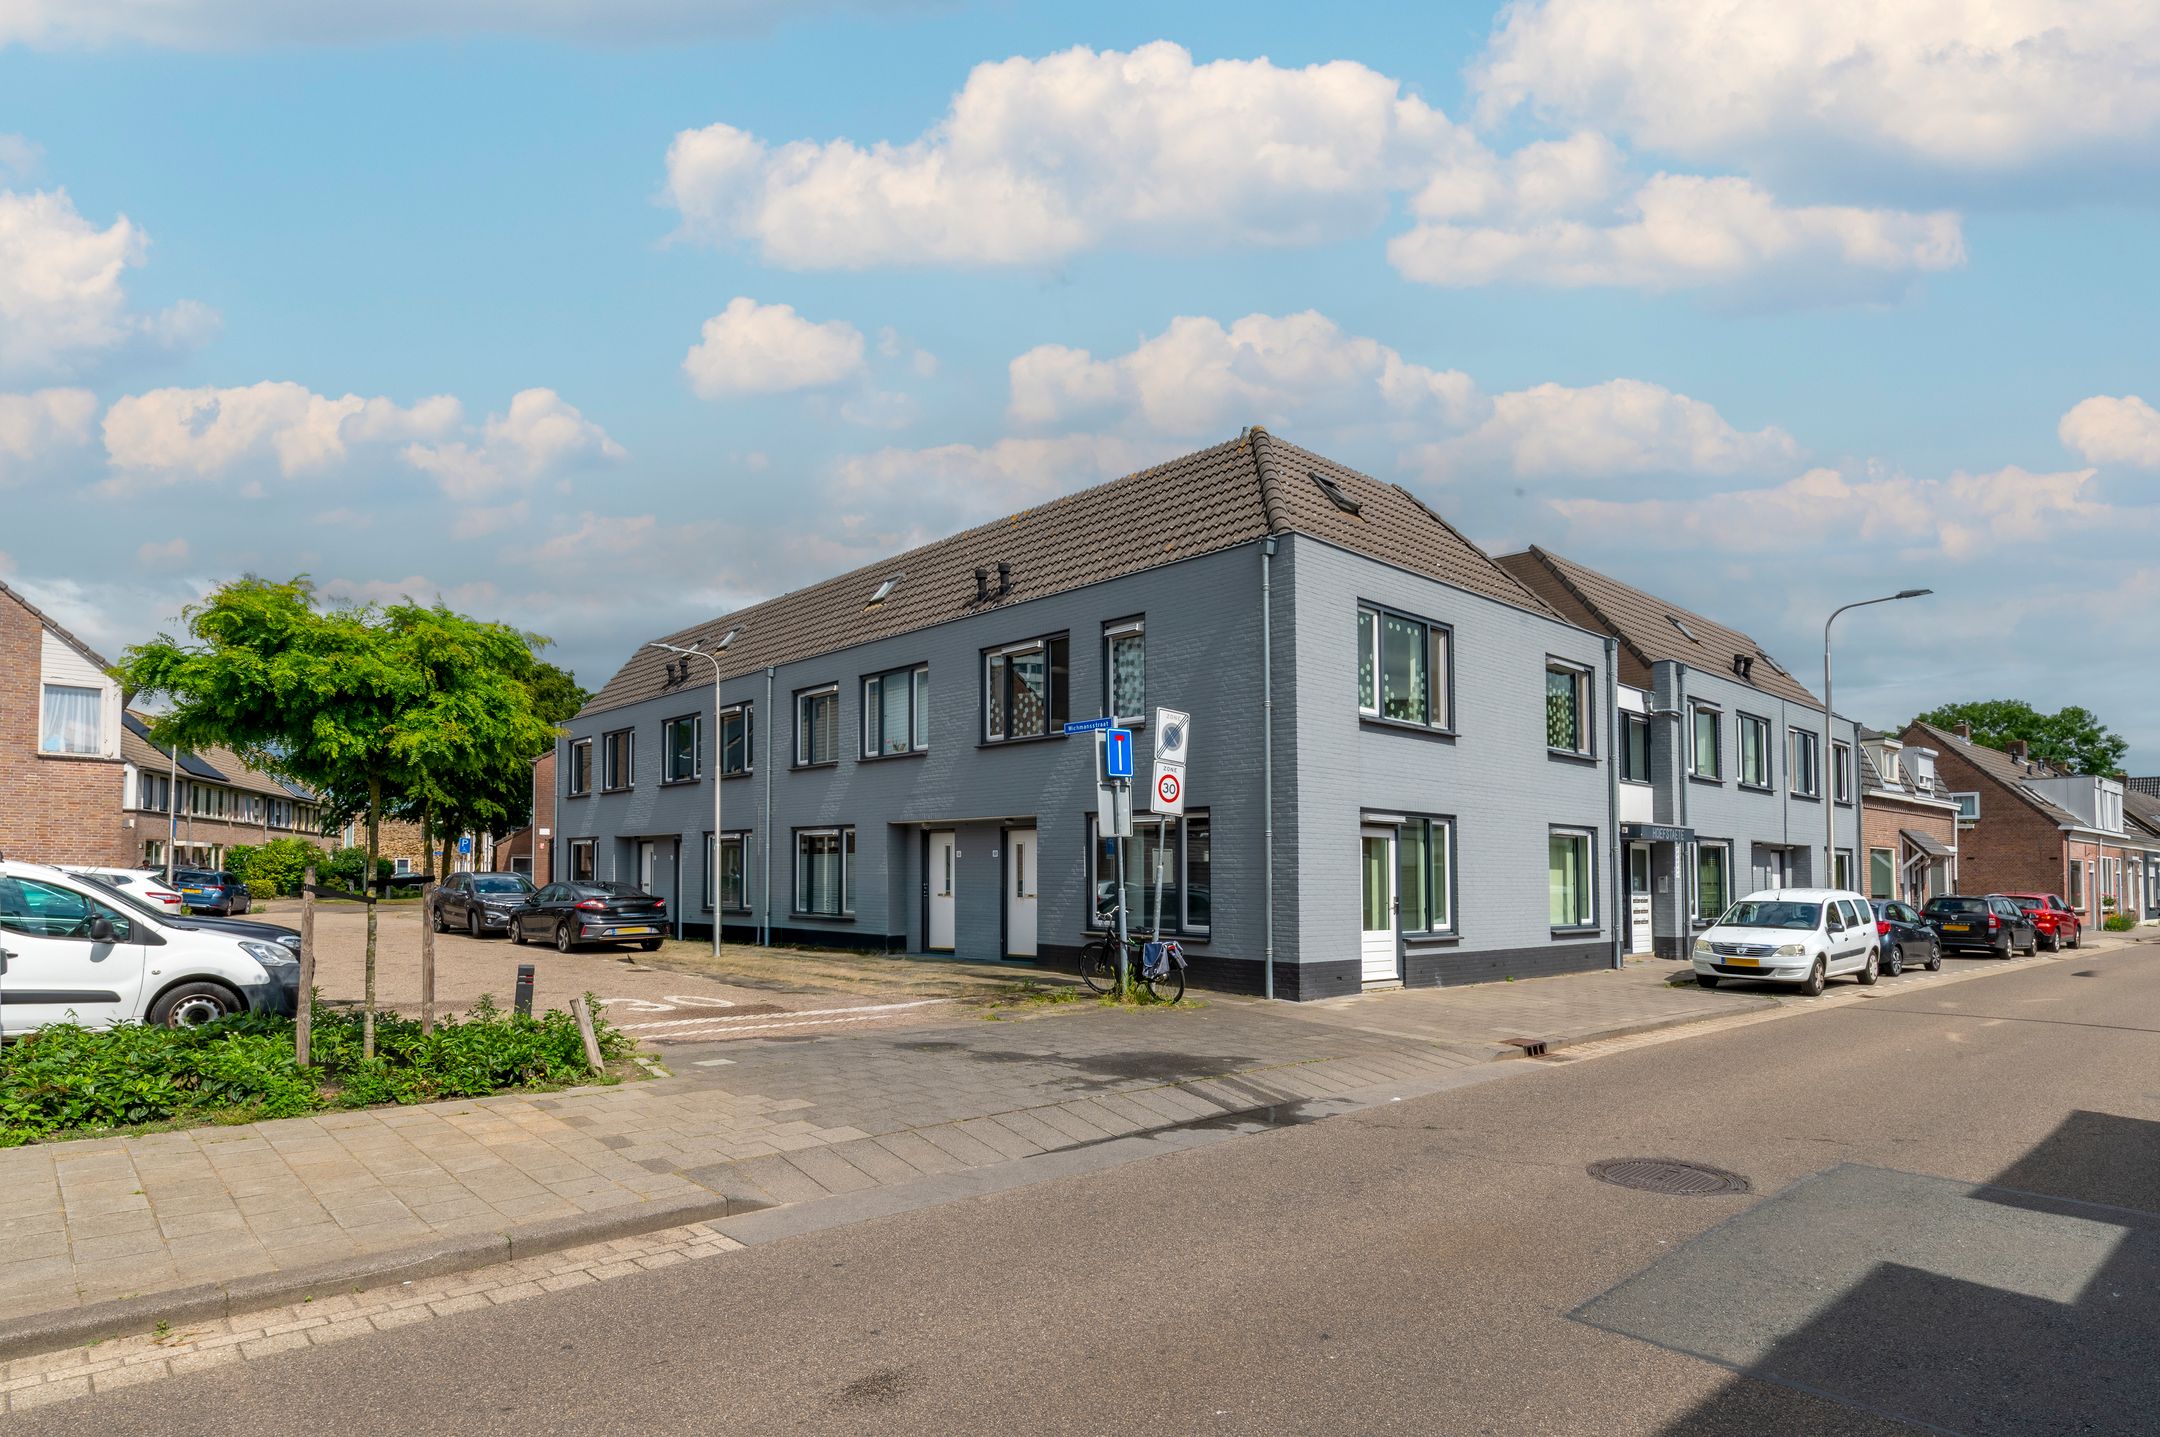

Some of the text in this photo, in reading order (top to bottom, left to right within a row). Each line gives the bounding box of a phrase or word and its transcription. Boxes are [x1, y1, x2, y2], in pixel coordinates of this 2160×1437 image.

[1068, 721, 1109, 731] Wichmansstraat
[1162, 782, 1176, 795] 30
[1653, 828, 1684, 840] HOEFSTAETE
